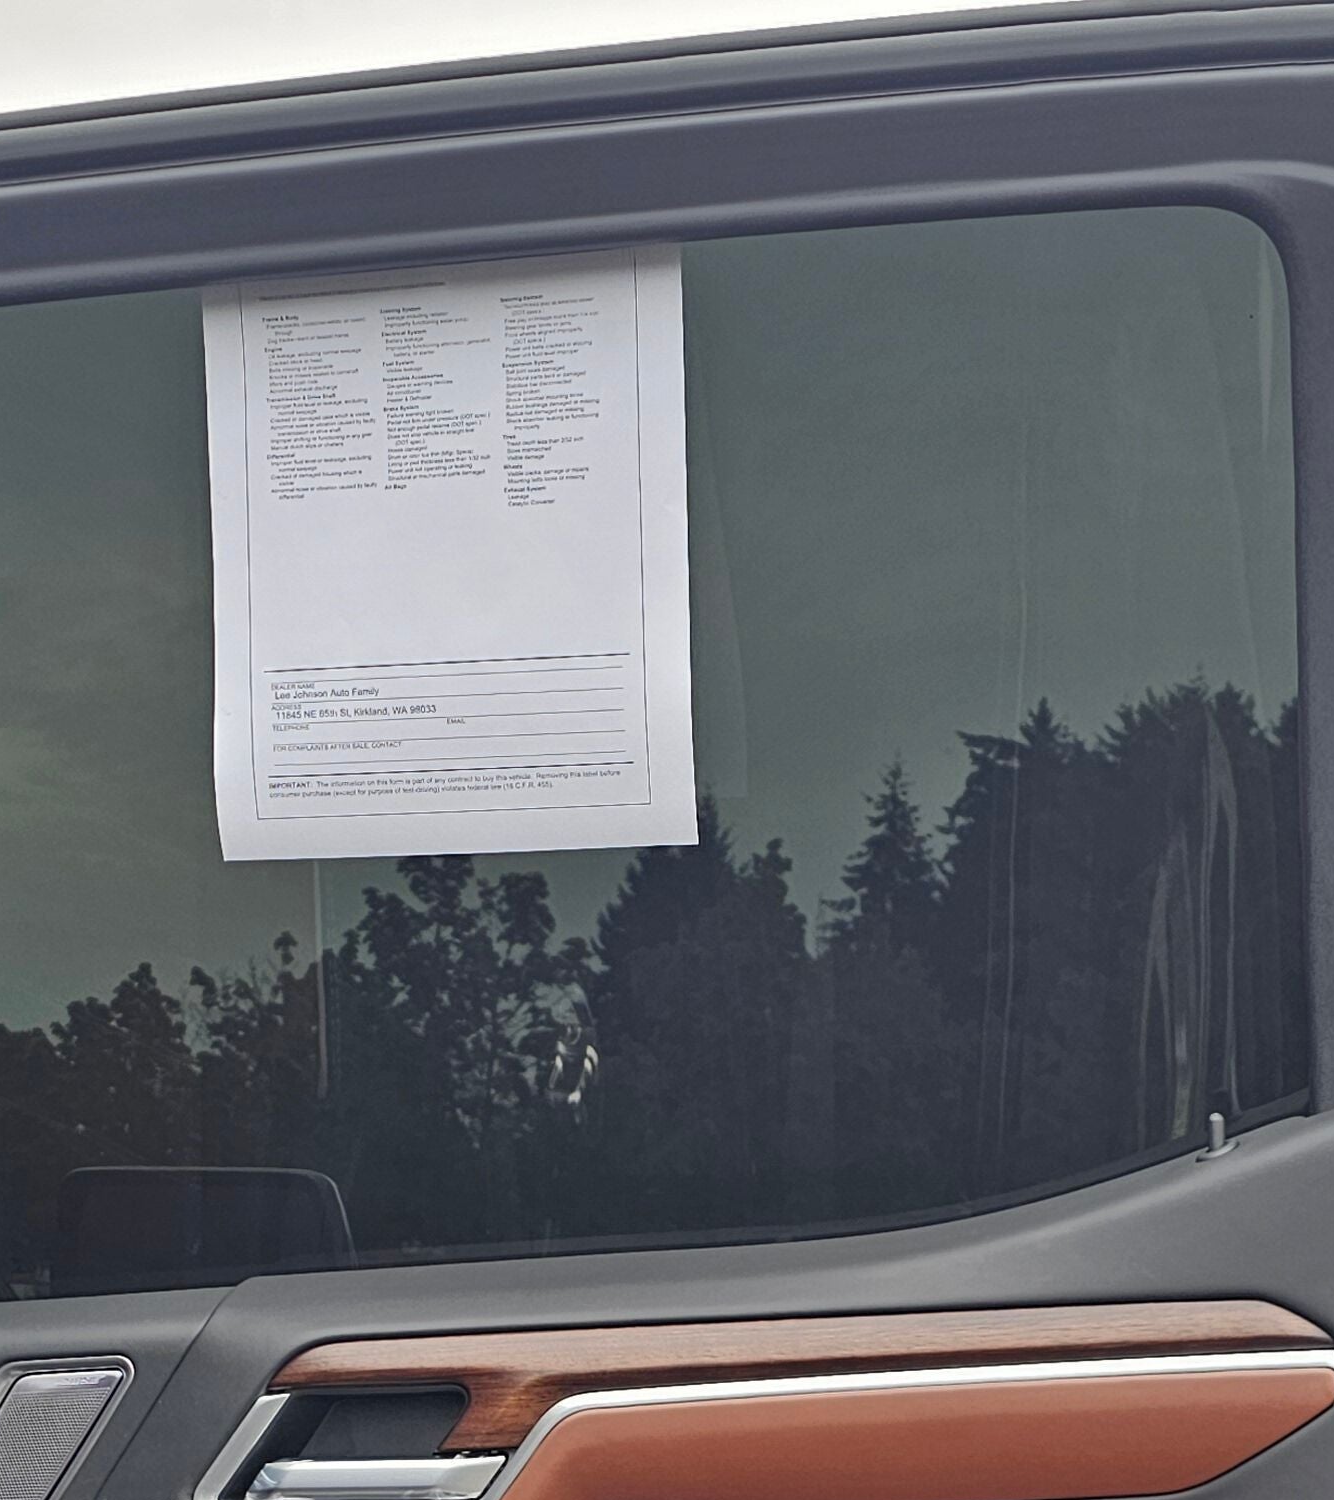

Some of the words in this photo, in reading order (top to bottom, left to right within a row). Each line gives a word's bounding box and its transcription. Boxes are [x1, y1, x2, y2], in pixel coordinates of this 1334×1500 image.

[275, 691, 290, 700] Lee
[293, 690, 328, 699] Johnson
[330, 688, 350, 697] Auto
[352, 687, 379, 697] Family
[277, 711, 301, 719] 11845
[304, 710, 316, 719] NE
[354, 707, 390, 716] Kirkland,
[392, 706, 407, 714] WA
[410, 704, 436, 714] 98033
